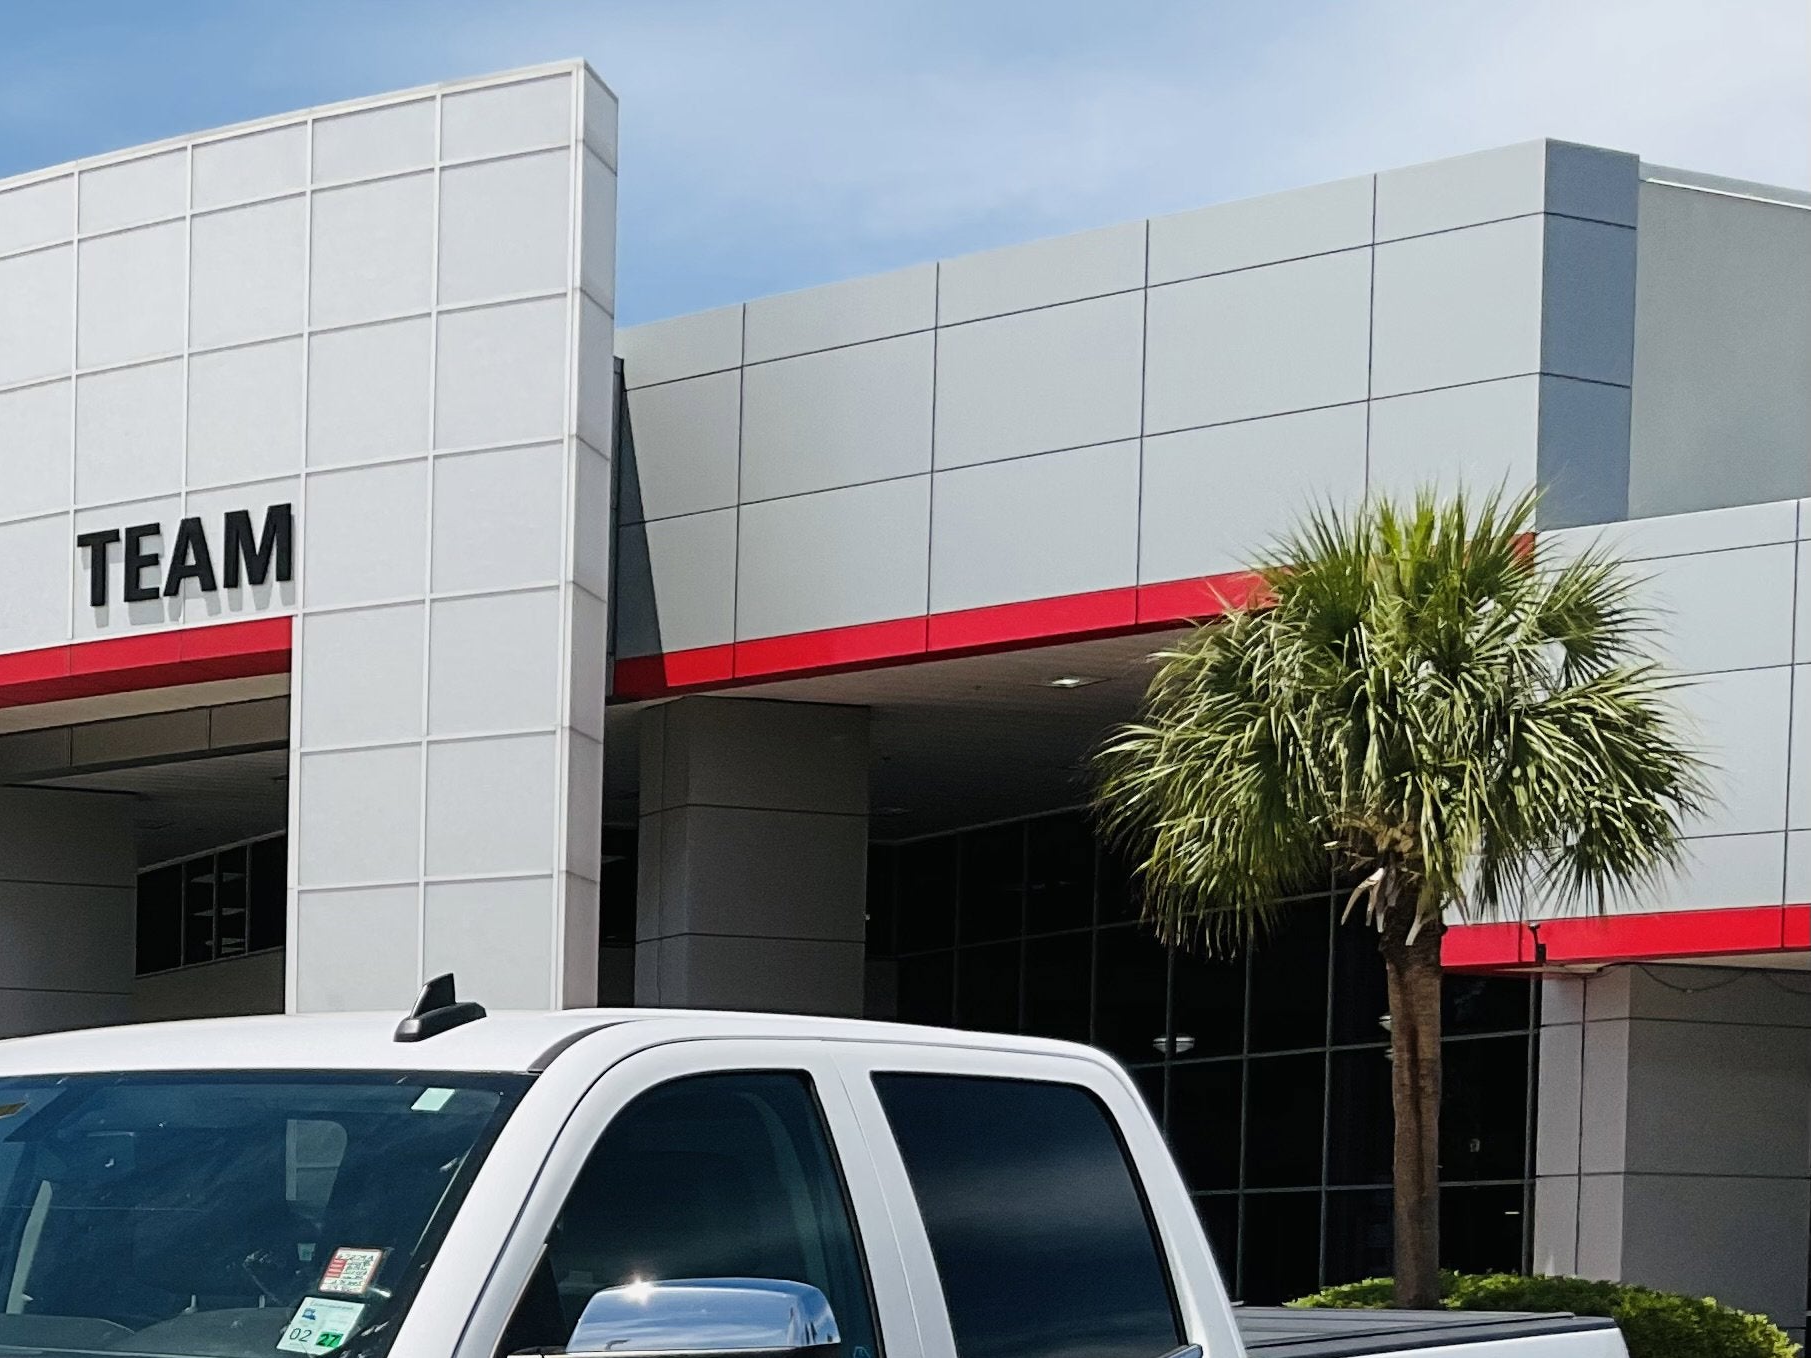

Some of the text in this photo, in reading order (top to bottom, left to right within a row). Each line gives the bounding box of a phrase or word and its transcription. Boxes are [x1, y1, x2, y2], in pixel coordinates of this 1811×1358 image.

[77, 503, 292, 607] TEAM
[289, 1327, 342, 1347] 02 27
